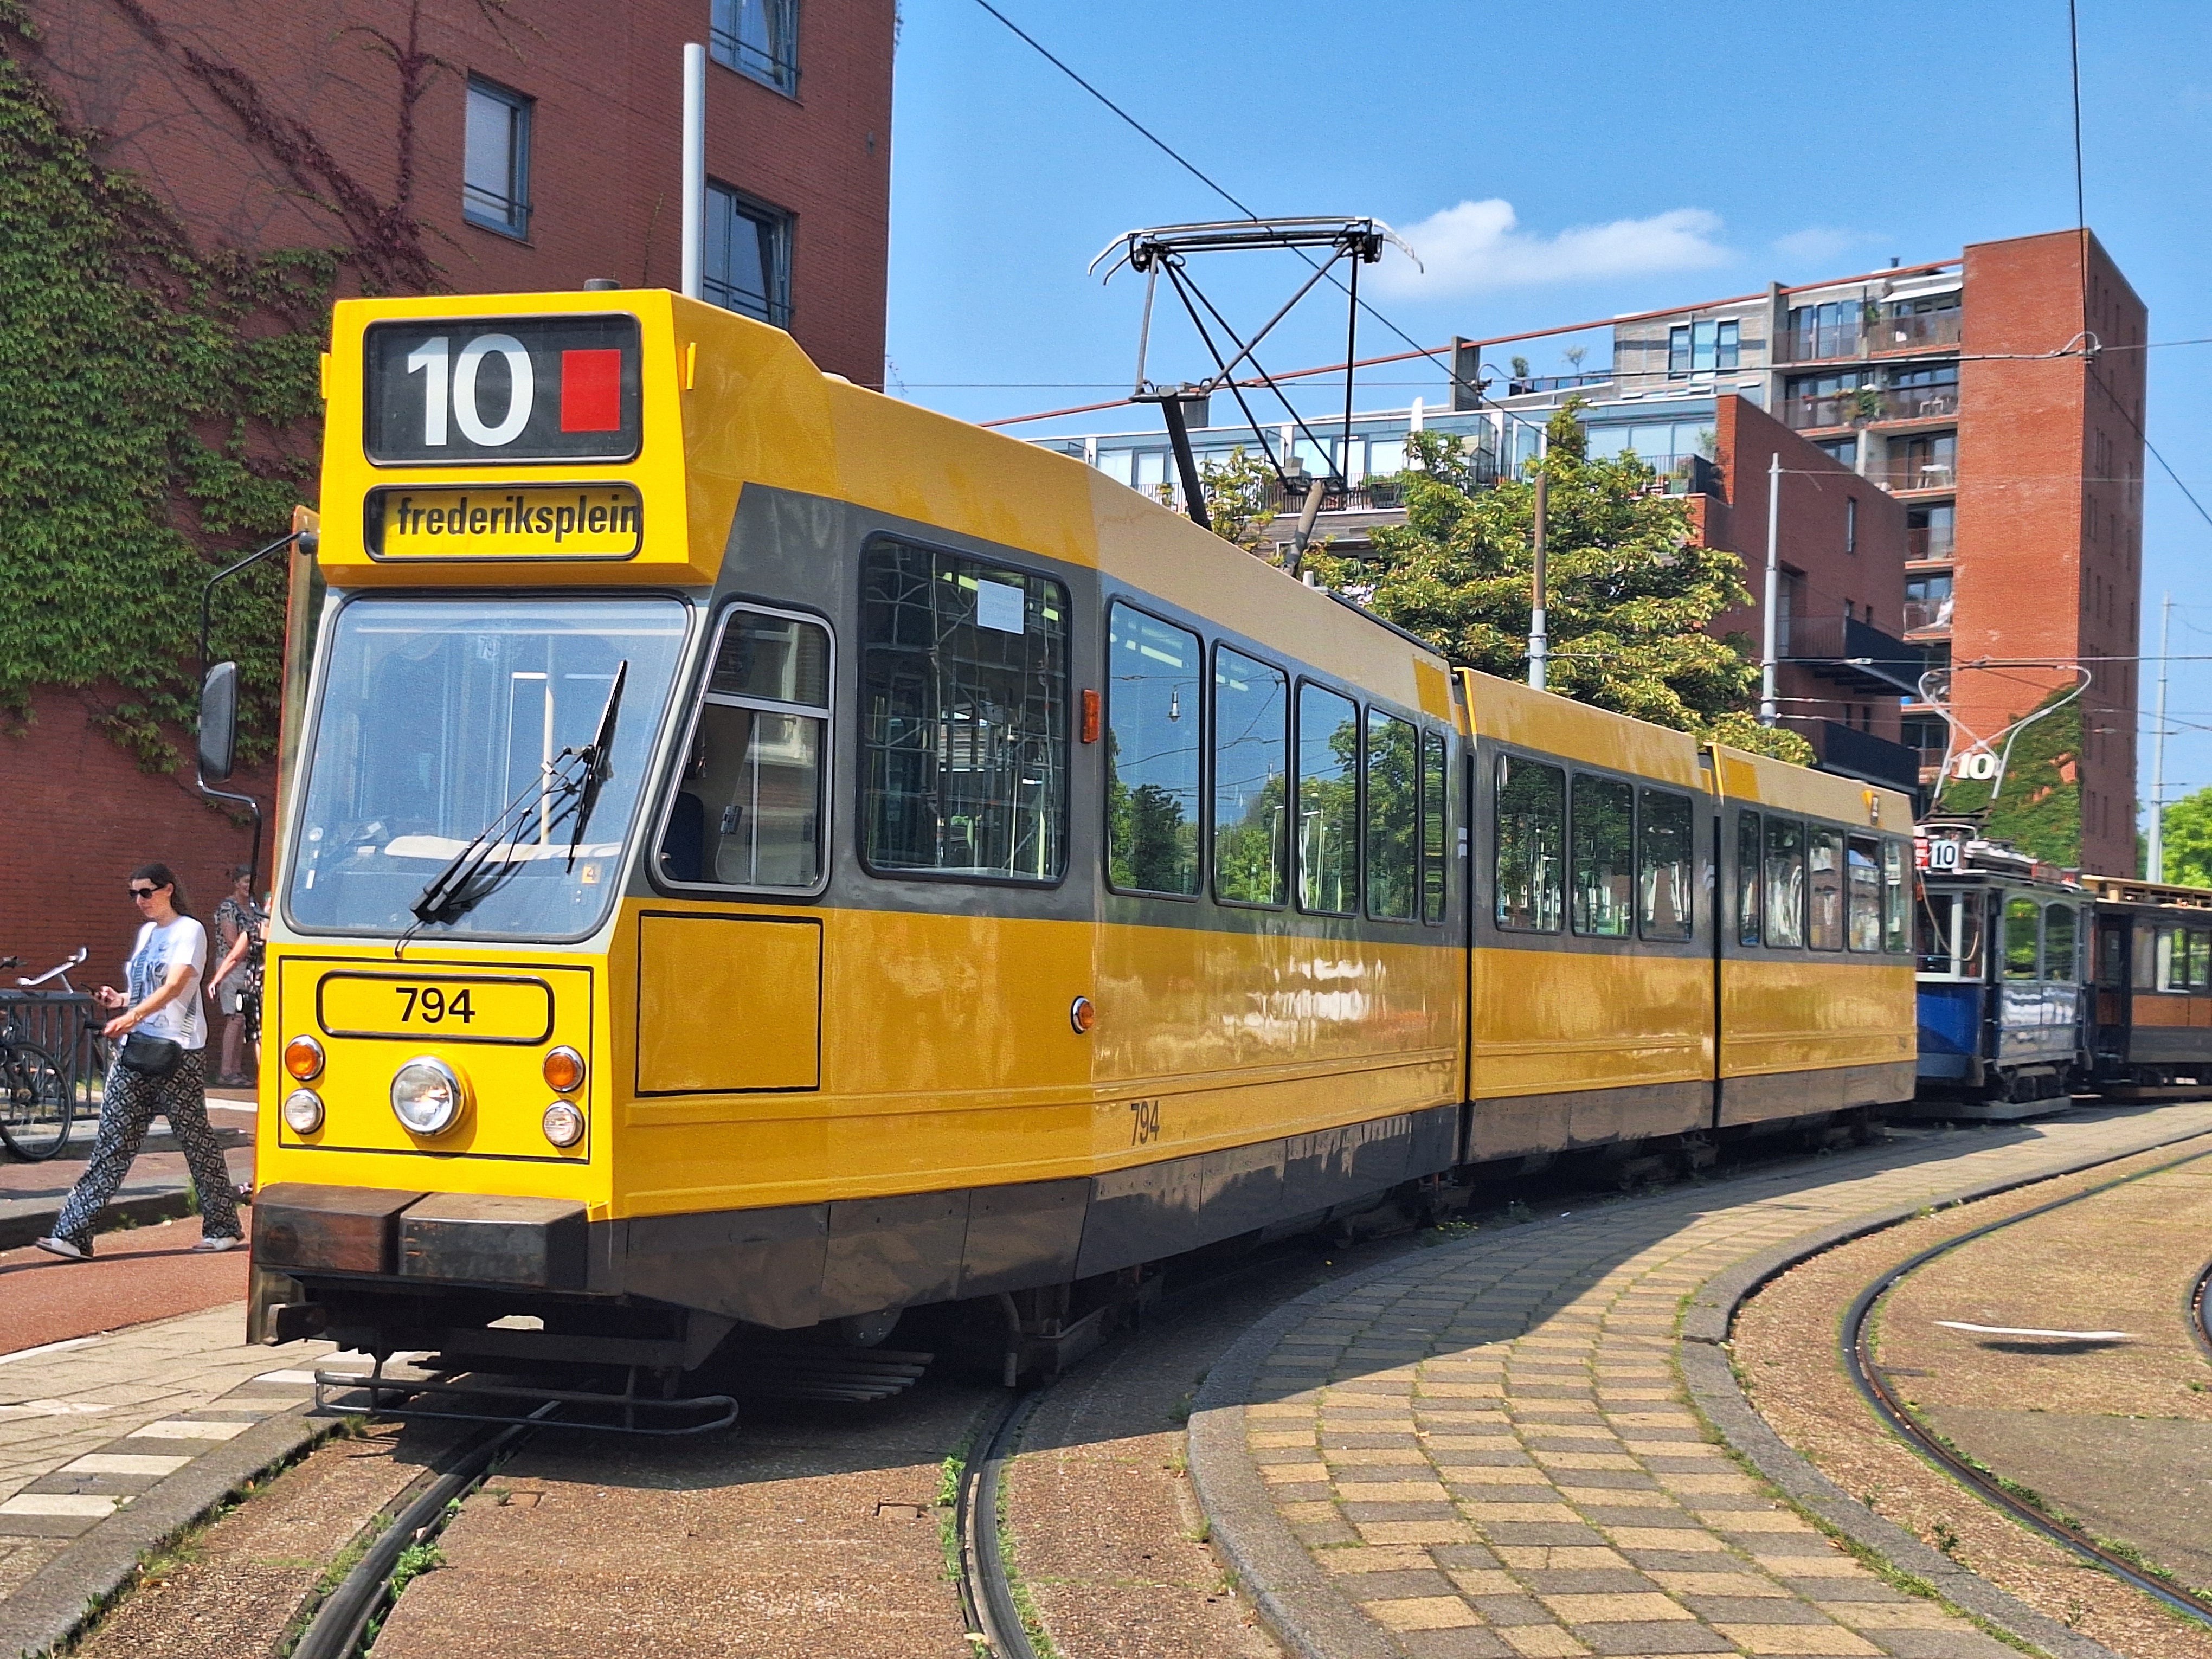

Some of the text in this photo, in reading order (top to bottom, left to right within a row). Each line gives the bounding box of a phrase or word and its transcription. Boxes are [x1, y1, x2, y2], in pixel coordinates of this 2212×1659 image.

[407, 333, 534, 446] 10
[398, 494, 639, 543] frederiksplein
[1954, 752, 1995, 780] 10
[1936, 845, 1956, 865] 10
[396, 987, 475, 1023] 794
[1131, 1100, 1160, 1146] 794
